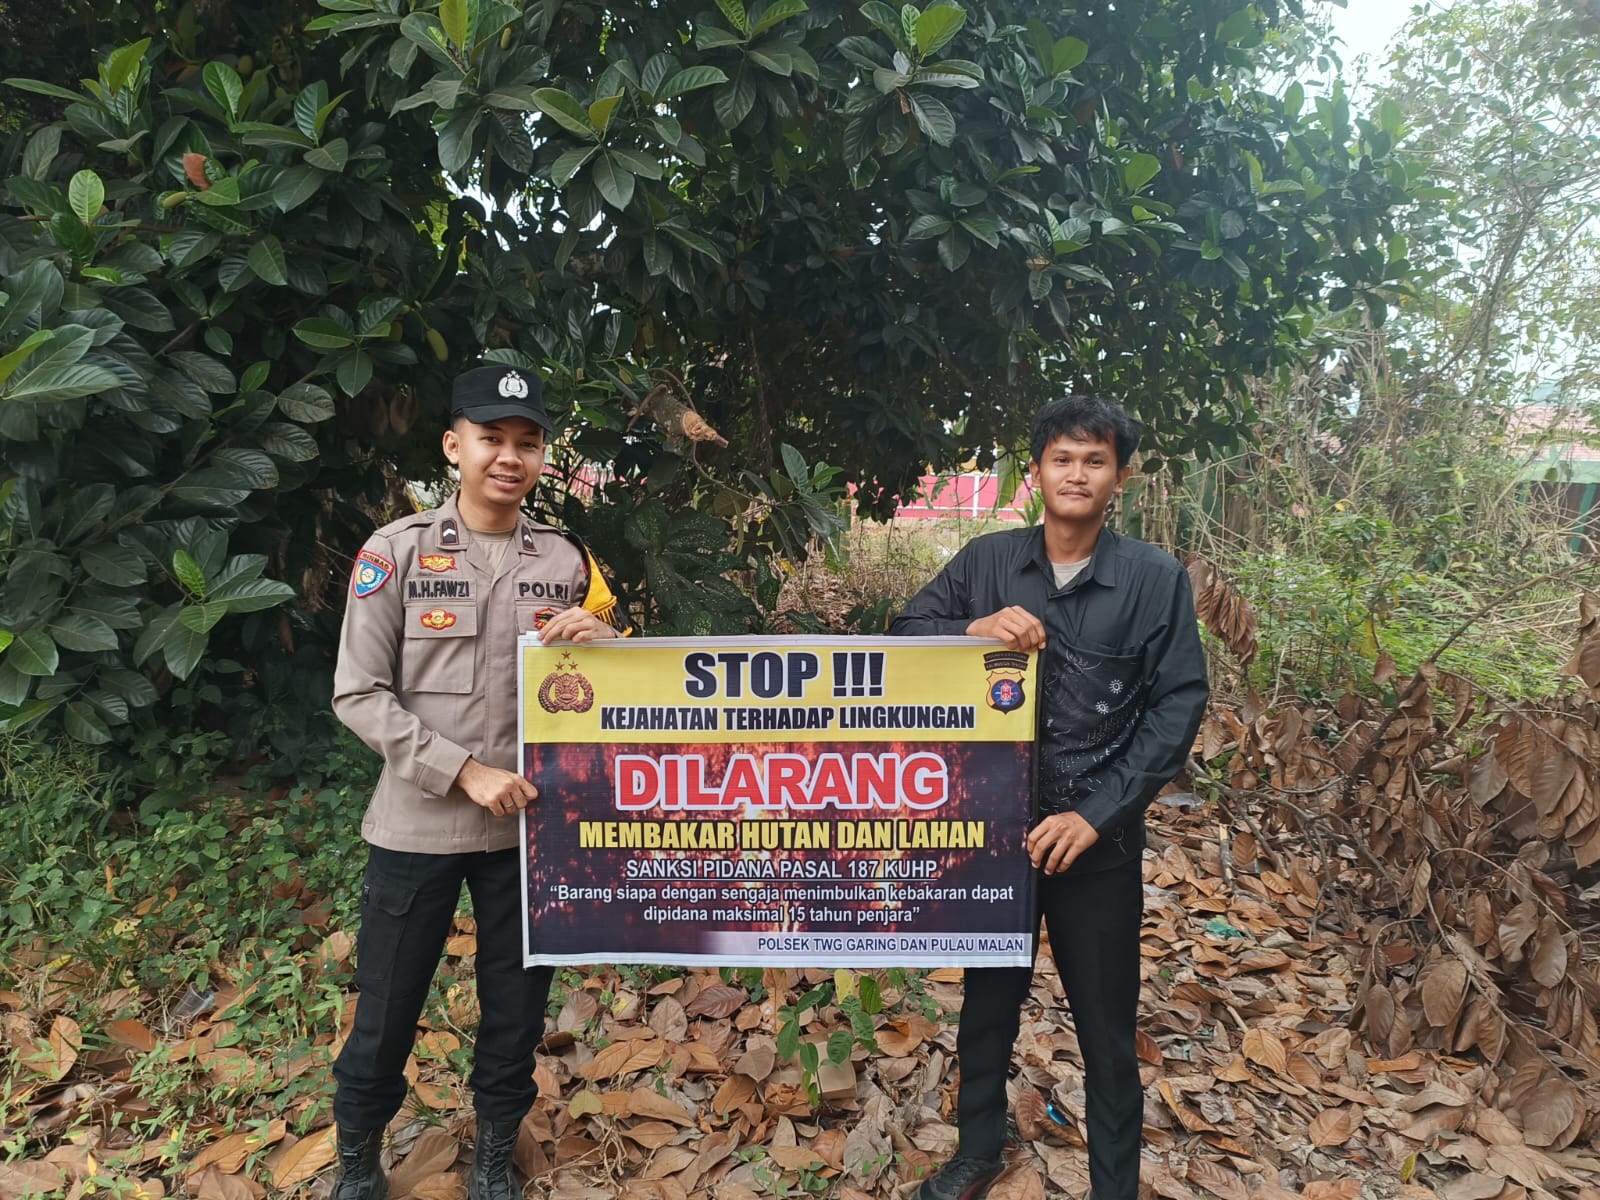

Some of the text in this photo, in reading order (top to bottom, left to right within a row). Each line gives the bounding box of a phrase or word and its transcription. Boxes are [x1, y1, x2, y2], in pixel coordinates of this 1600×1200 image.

[408, 580, 470, 599] M.H.FAWZI
[518, 582, 569, 600] POLRI
[684, 651, 885, 699] STOP !!!
[601, 705, 975, 730] KEJAHATAN TERHADAP LINGKUNGAN
[617, 754, 946, 808] DILARANG
[579, 821, 985, 849] MEMBAKAR HUTAN DAN LAHAN
[626, 860, 937, 878] SANKSI PIDANA PASAL 187 KUHP
[550, 885, 1014, 904] “Barang siapa dengan sengaja menimbulkan kebakaran dapat
[643, 906, 920, 925] dipidana maksimal 15 tahun penjara”
[758, 938, 1024, 951] POLSEK TWG GARING DAN PULAU MALAN
